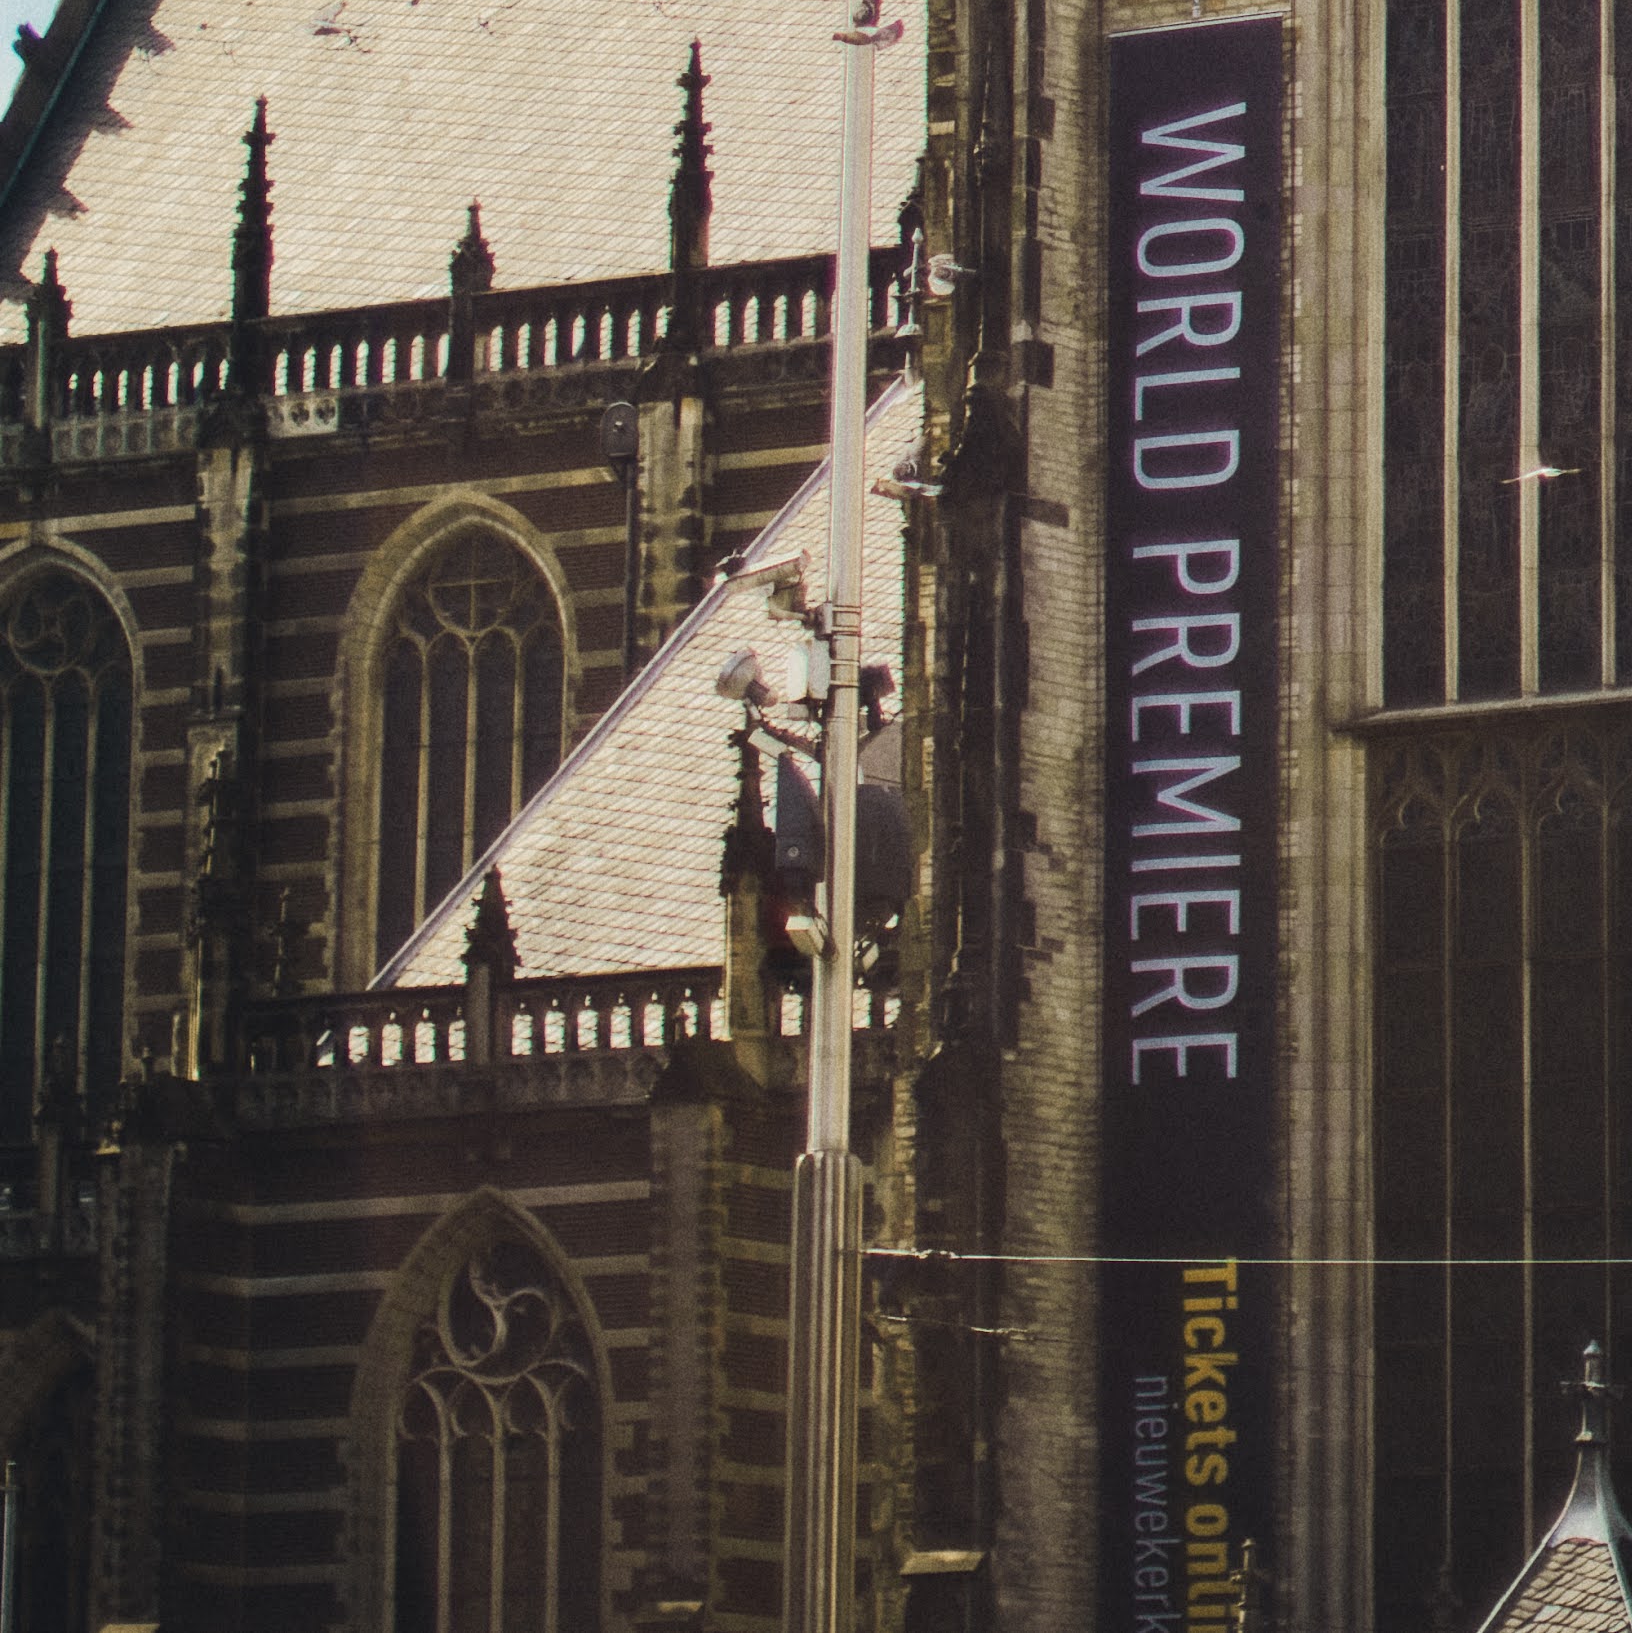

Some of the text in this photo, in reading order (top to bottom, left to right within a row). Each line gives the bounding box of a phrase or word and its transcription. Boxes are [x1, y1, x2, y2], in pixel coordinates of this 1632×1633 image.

[1131, 101, 1247, 1085] WORLD PREMIERE
[1182, 1257, 1239, 1486] Tickets
